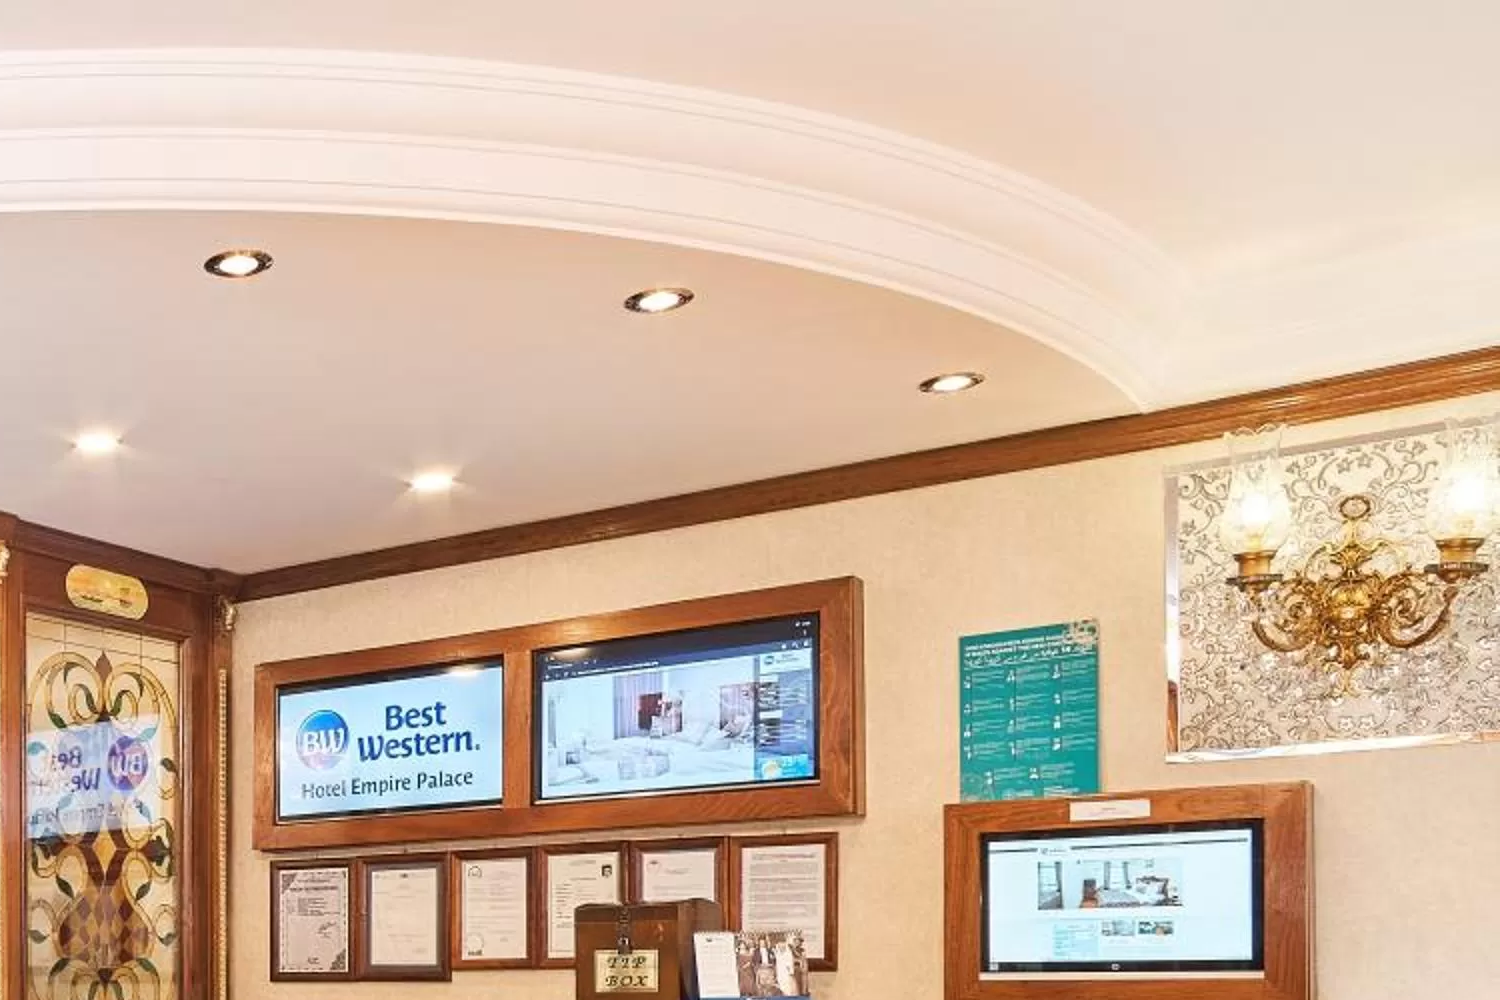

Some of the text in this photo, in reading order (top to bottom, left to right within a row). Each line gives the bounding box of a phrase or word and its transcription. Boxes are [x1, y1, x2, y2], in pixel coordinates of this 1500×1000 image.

[385, 701, 447, 731] Best
[302, 727, 346, 754] BW
[302, 770, 473, 799] Hotel Empire Palace
[606, 956, 648, 969] TIP
[605, 974, 649, 987] BOX
